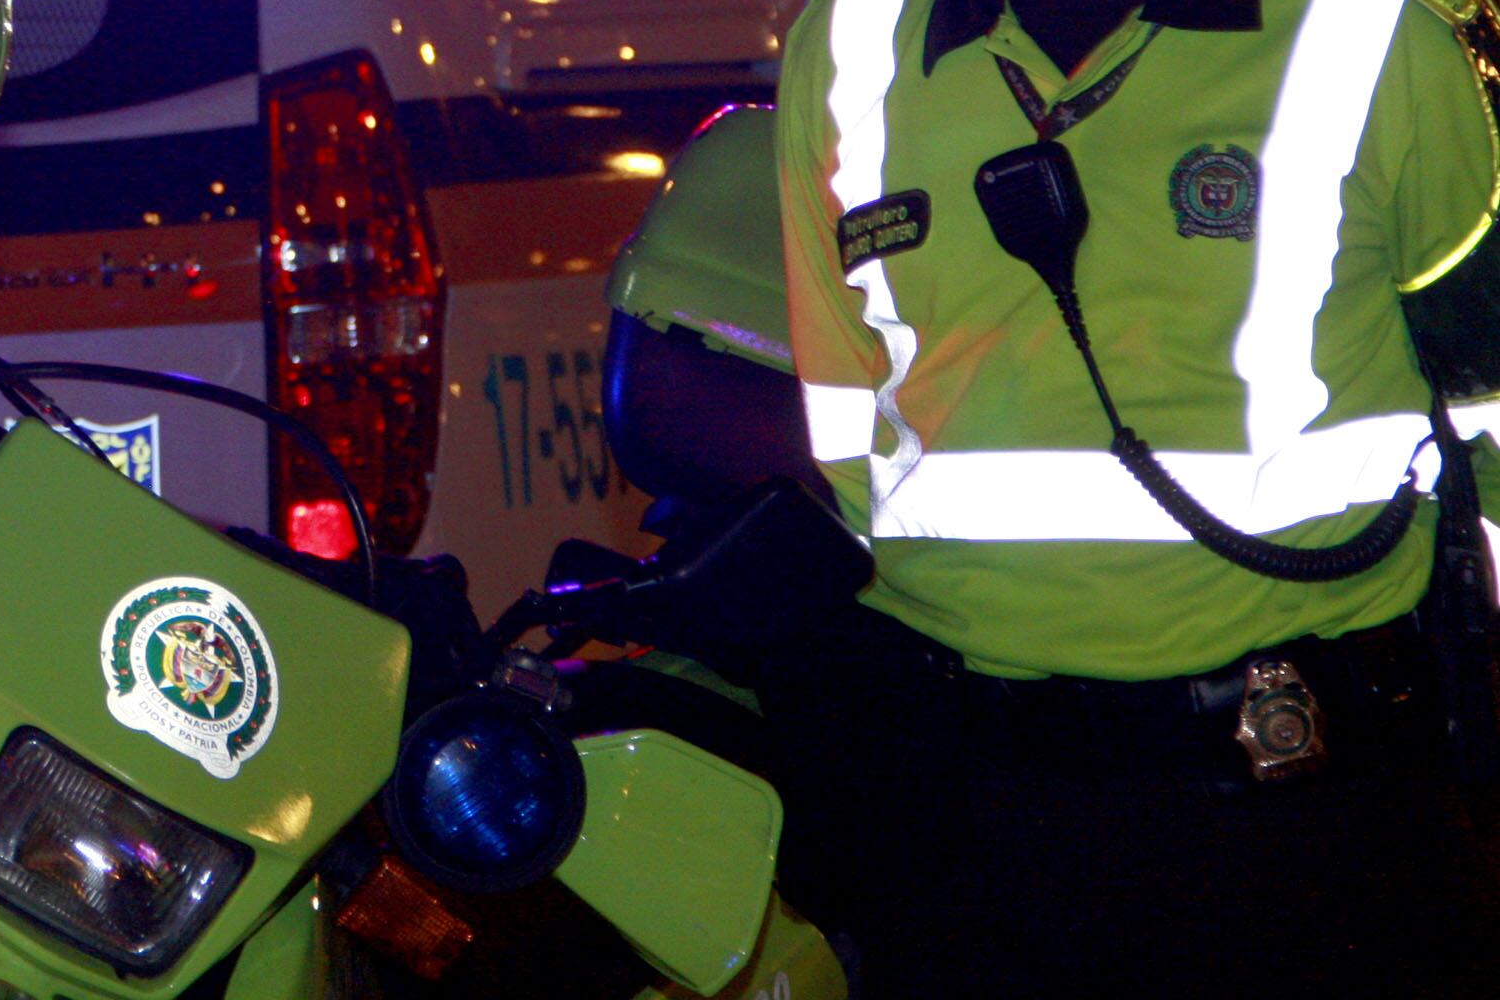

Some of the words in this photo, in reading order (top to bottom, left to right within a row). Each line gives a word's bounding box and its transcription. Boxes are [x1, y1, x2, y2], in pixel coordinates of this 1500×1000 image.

[135, 605, 193, 649] REPUBLICA
[234, 634, 257, 711] COLOMBIA
[135, 665, 169, 713] POLICIA
[183, 716, 240, 733] NACIONAL
[178, 729, 219, 750] PATRIA
